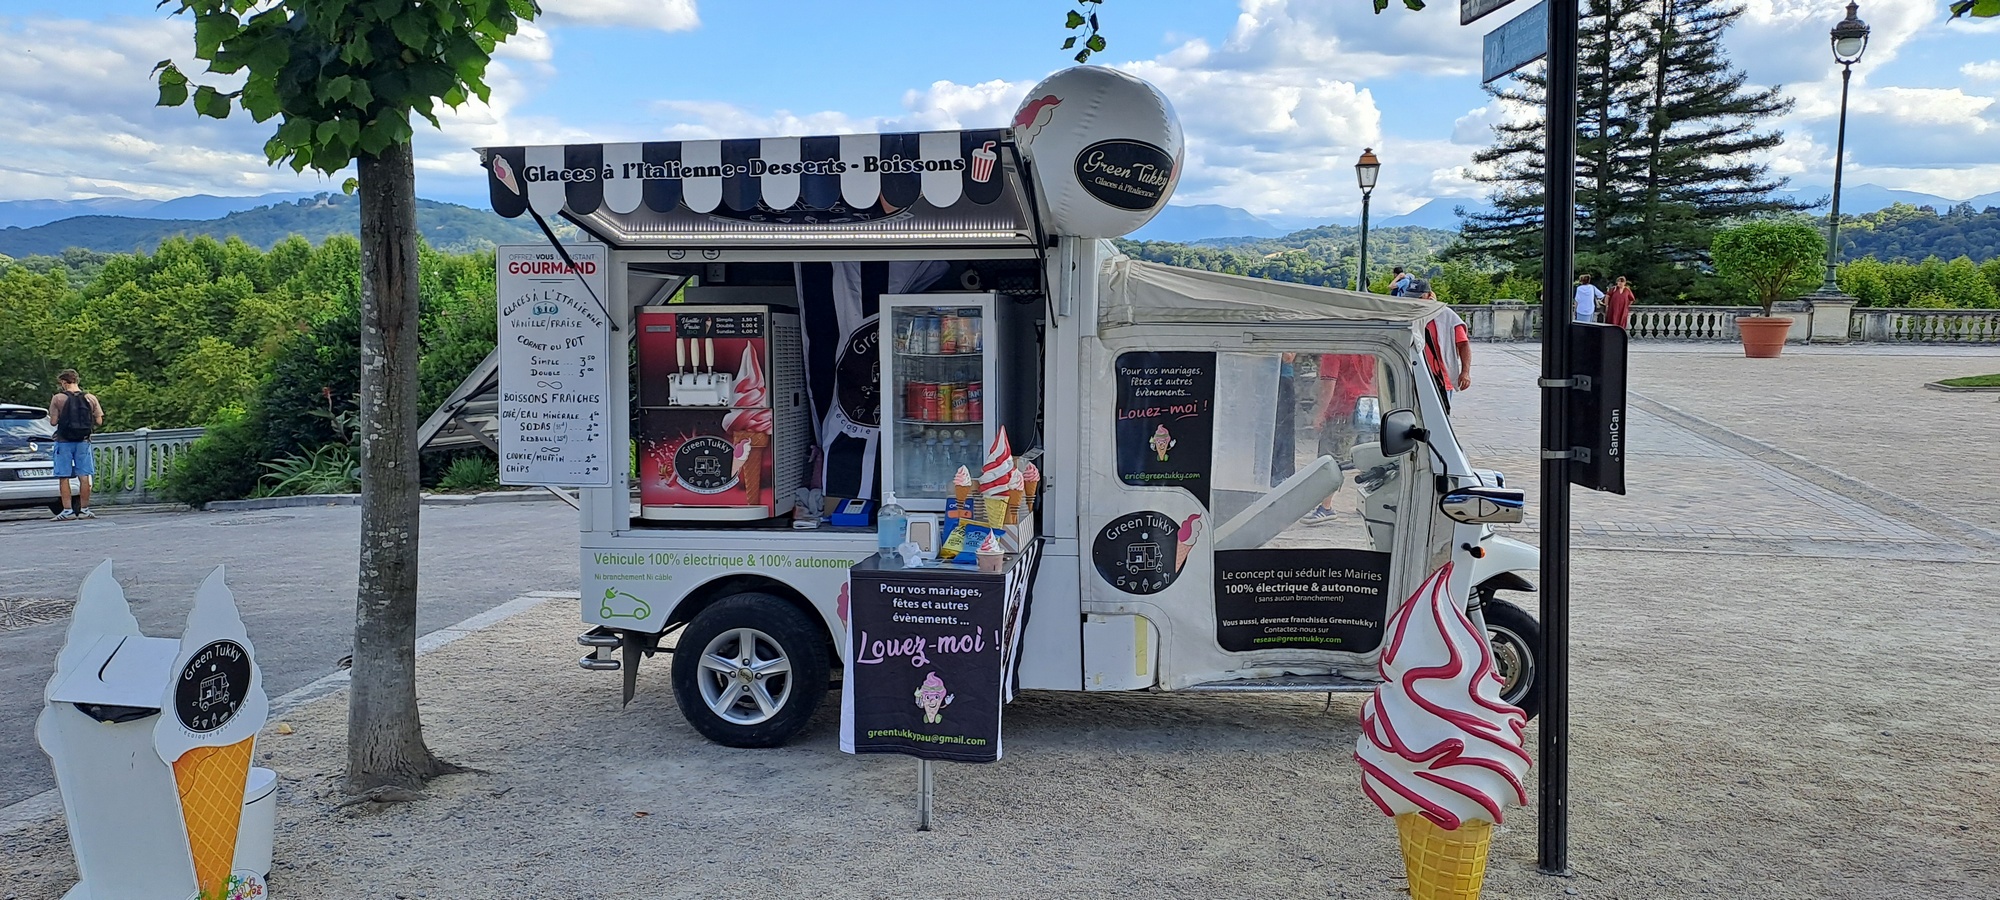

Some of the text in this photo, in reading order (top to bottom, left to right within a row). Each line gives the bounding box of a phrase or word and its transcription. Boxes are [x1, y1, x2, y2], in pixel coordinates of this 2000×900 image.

[525, 165, 596, 183] Glaces
[603, 164, 614, 180] à
[750, 158, 847, 176] Desserts
[863, 155, 966, 173] Boissons
[1083, 150, 1169, 191] Green Tukky
[1095, 177, 1118, 189] Glaces
[508, 261, 596, 275] GOURMAND
[503, 293, 531, 316] GLACES
[517, 334, 547, 351] CORNET
[565, 335, 585, 350] POT
[1121, 367, 1141, 376] Pour
[1161, 366, 1204, 376] mariages,
[1130, 377, 1193, 386] fêtes et autres
[503, 391, 548, 404] BOISSONS
[1118, 400, 1198, 420] Louez-moi
[520, 422, 551, 431] SODAS
[681, 438, 731, 455] Green Tukky
[506, 463, 530, 473] CHIPS
[1124, 471, 1201, 482] eric@greentukky.com
[1106, 514, 1175, 540] Green Tukky
[594, 552, 855, 569] Véhicule 100% électrique & 100% autonome
[594, 572, 673, 581] Ni branchement Ni câble
[1222, 567, 1382, 581] Le concept qui séduit les Mairies
[880, 583, 983, 598] Pour vos mariages,
[1225, 582, 1379, 596] 100% électrique & autonome
[892, 597, 969, 611] fêtes et autres
[892, 612, 958, 625] évènements
[1239, 618, 1259, 626] aussi,
[1260, 617, 1289, 625] devenez
[1290, 615, 1328, 624] franchisés
[1329, 616, 1374, 629] Greentukky
[1264, 626, 1316, 634] Contactez-nous
[1253, 634, 1342, 644] reseau@greentukky.com
[857, 626, 986, 668] Louez-moi
[184, 644, 242, 680] Green Tukky
[867, 728, 987, 746] greentukkypau@gmail.com
